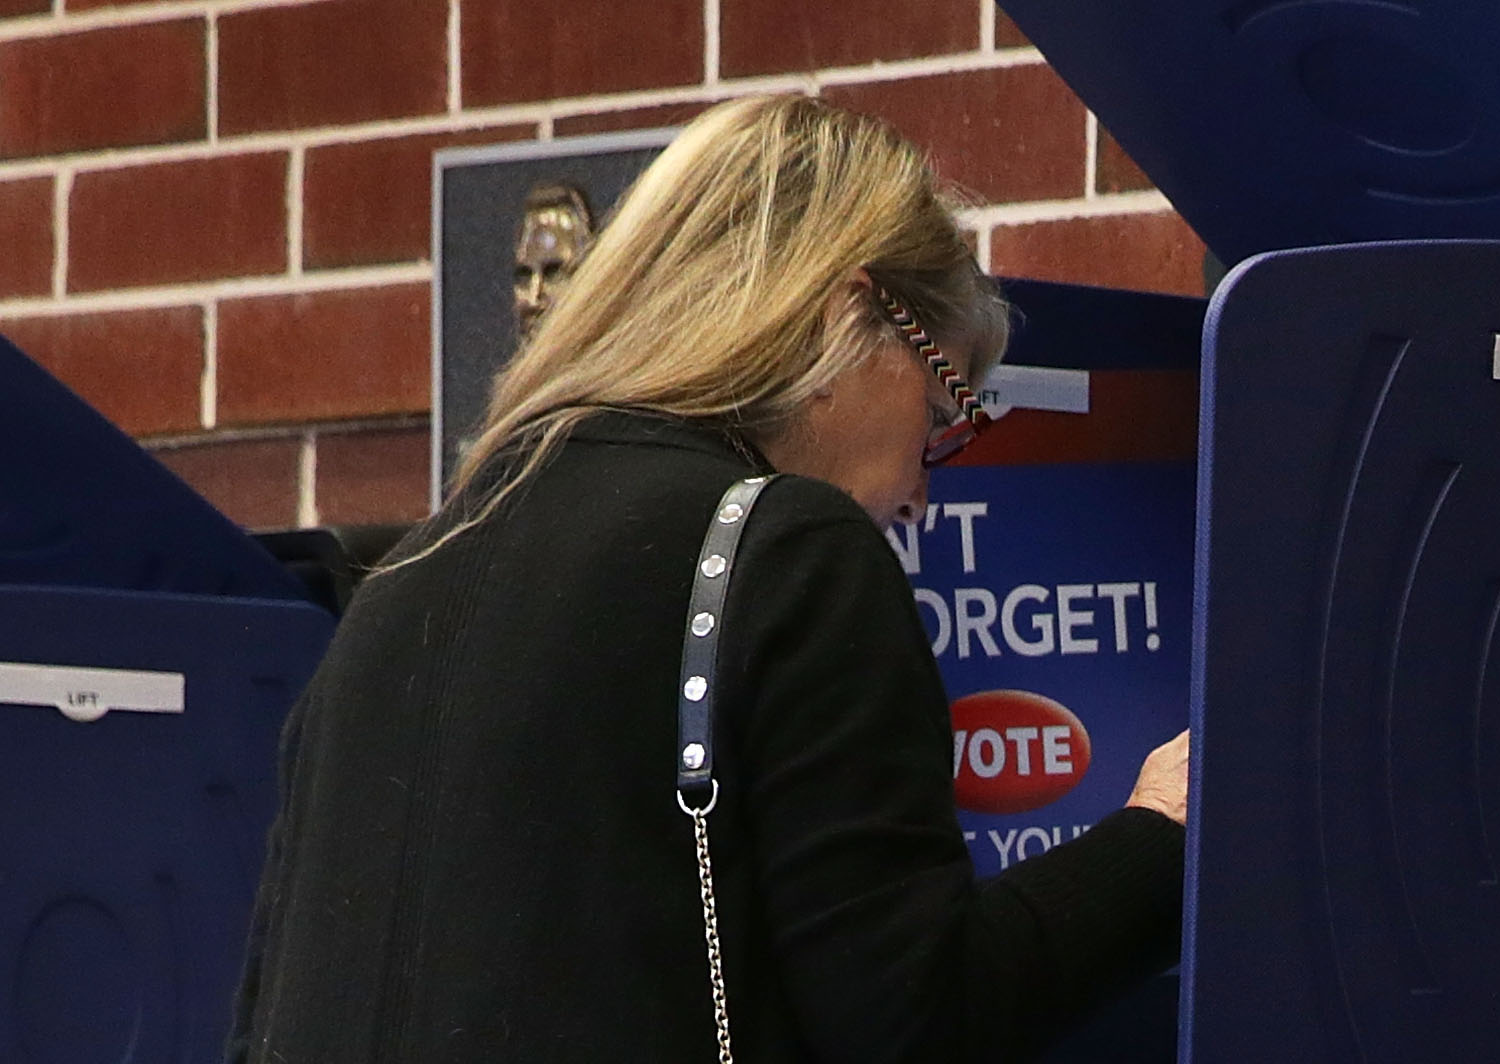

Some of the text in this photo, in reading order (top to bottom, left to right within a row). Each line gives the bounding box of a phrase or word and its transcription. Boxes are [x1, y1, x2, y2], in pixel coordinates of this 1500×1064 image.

[978, 389, 1000, 405] IFT
[912, 581, 1161, 660] ORGET!
[67, 692, 100, 707] LIFT
